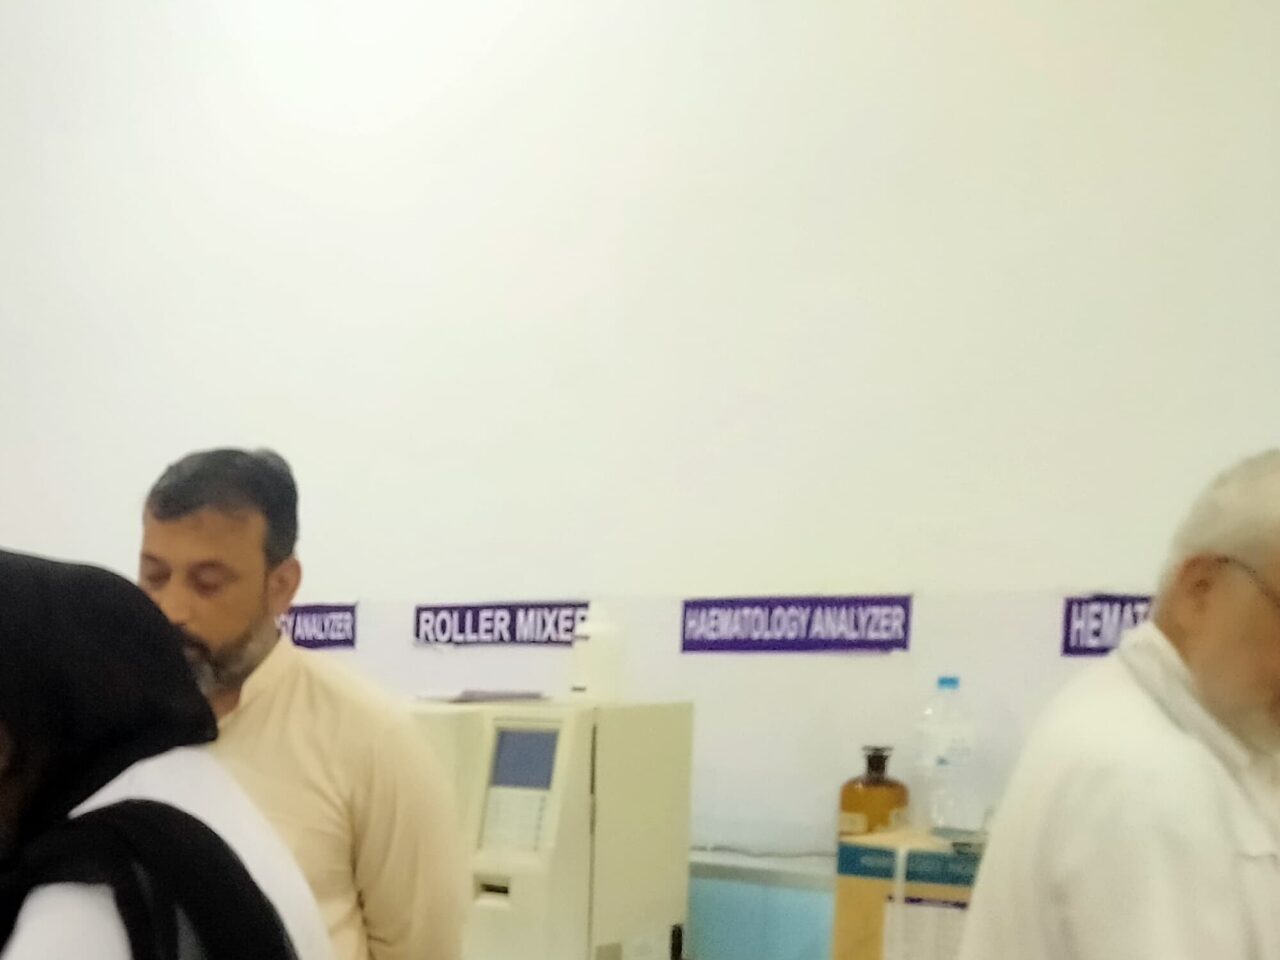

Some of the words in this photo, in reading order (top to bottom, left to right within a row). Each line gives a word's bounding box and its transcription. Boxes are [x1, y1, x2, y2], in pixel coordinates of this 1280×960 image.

[295, 611, 353, 640] ANALYZER
[419, 610, 511, 642] ROLLER
[685, 606, 808, 640] HAEMATOLOGY
[810, 605, 905, 638] ANALYZER
